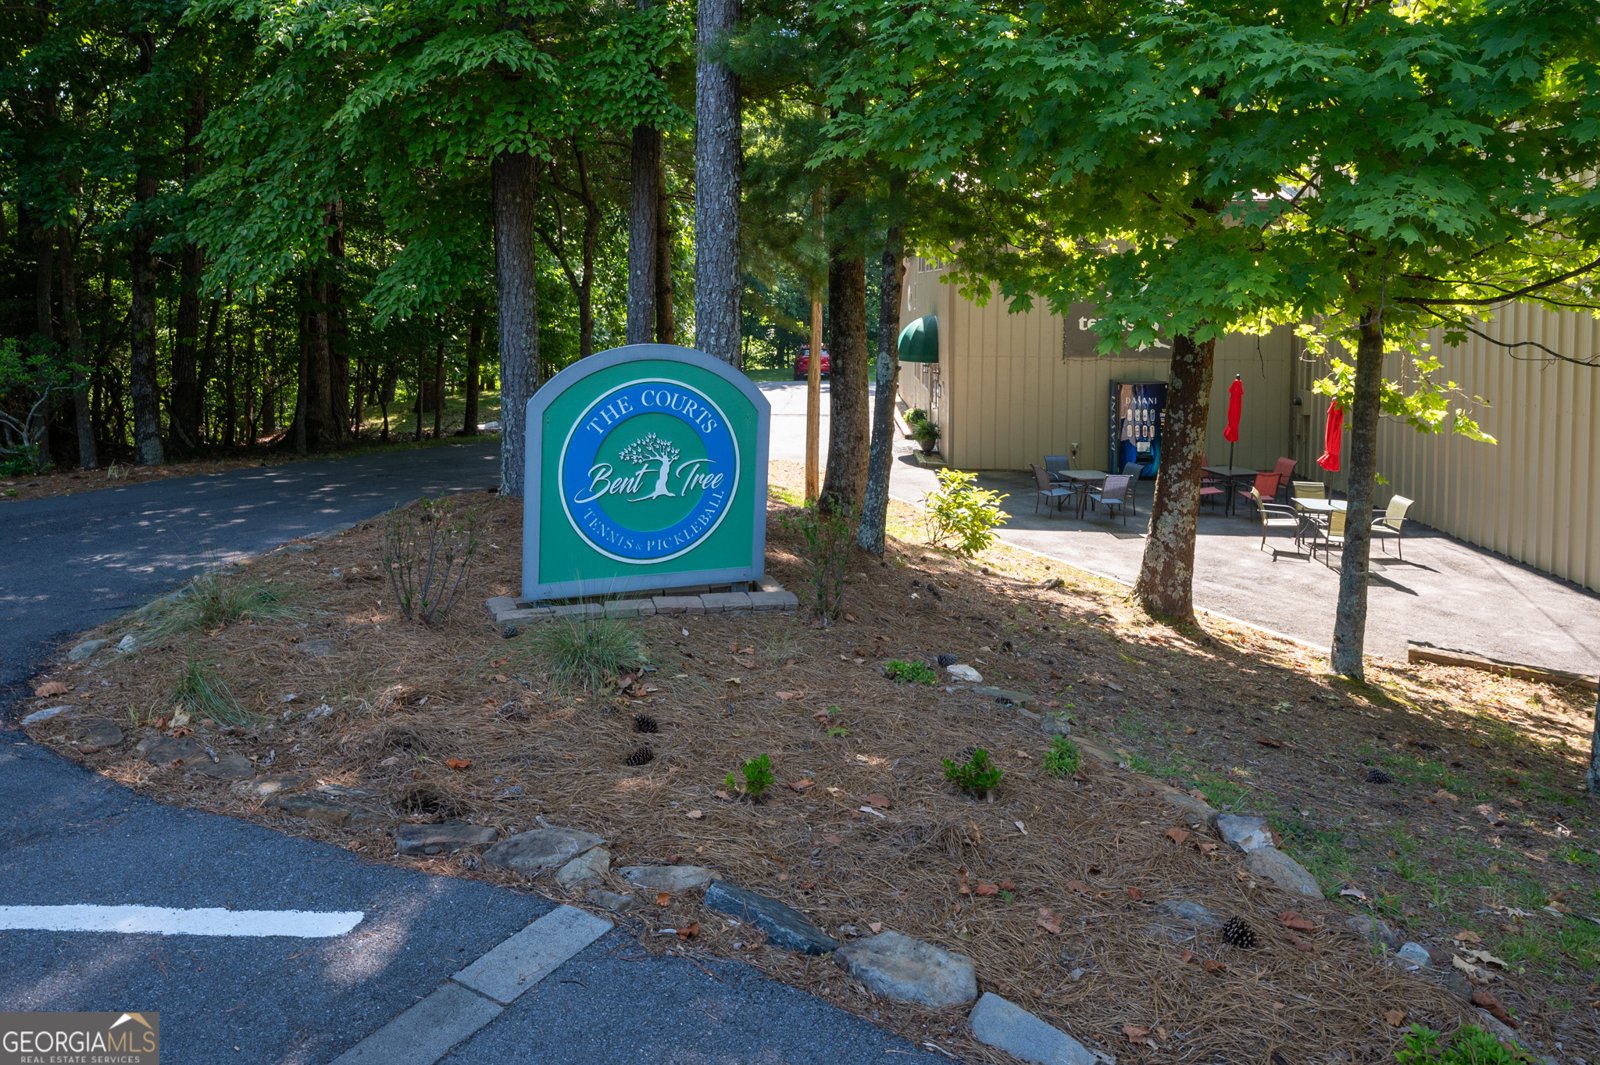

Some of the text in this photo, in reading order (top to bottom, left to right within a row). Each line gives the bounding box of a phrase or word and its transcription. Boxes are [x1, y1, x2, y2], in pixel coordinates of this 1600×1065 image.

[586, 389, 718, 435] THE COURTS
[1125, 396, 1158, 406] DASANI
[573, 458, 725, 504] Bent Tree
[583, 507, 634, 550] TENNIS
[646, 490, 725, 551] PICKLEBALL
